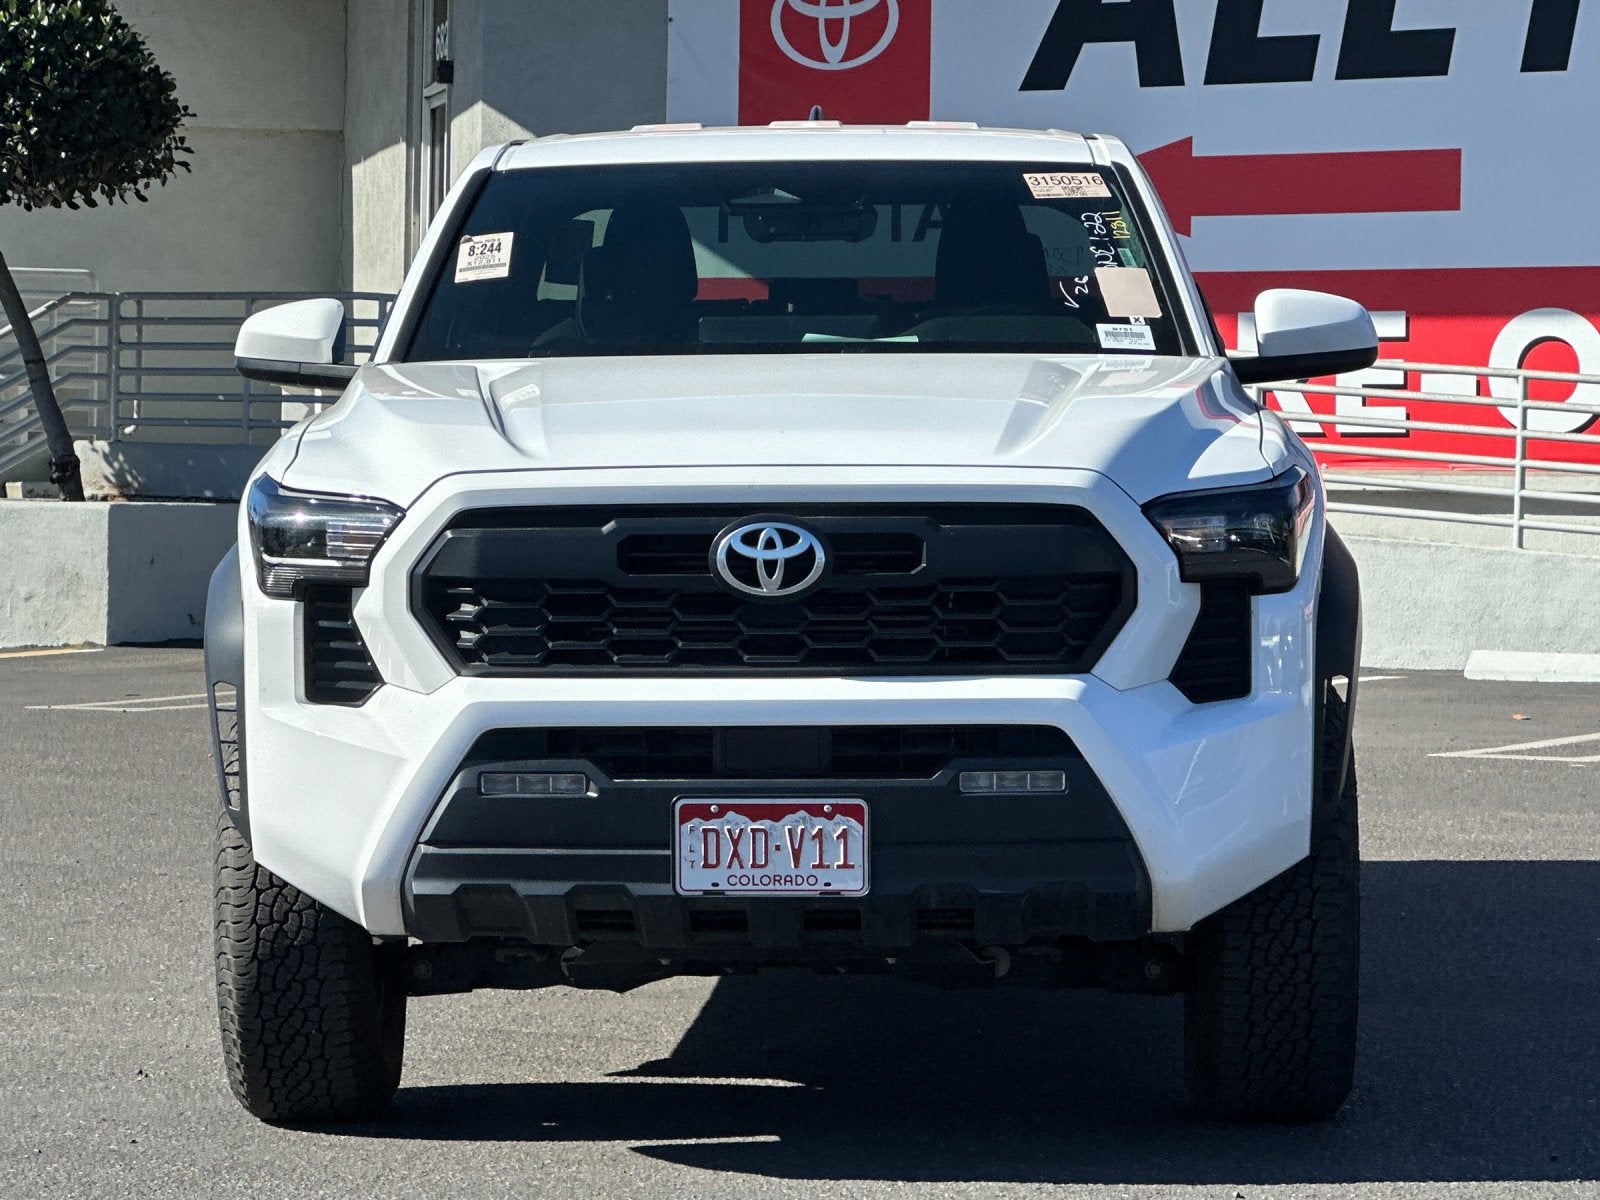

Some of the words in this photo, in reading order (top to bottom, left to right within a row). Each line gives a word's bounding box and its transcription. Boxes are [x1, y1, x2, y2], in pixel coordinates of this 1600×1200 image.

[1028, 175, 1104, 186] 3150516
[468, 242, 502, 257] 8:244
[1089, 243, 1119, 270] NE
[1073, 275, 1090, 295] 26
[726, 873, 819, 888] COLORADO
